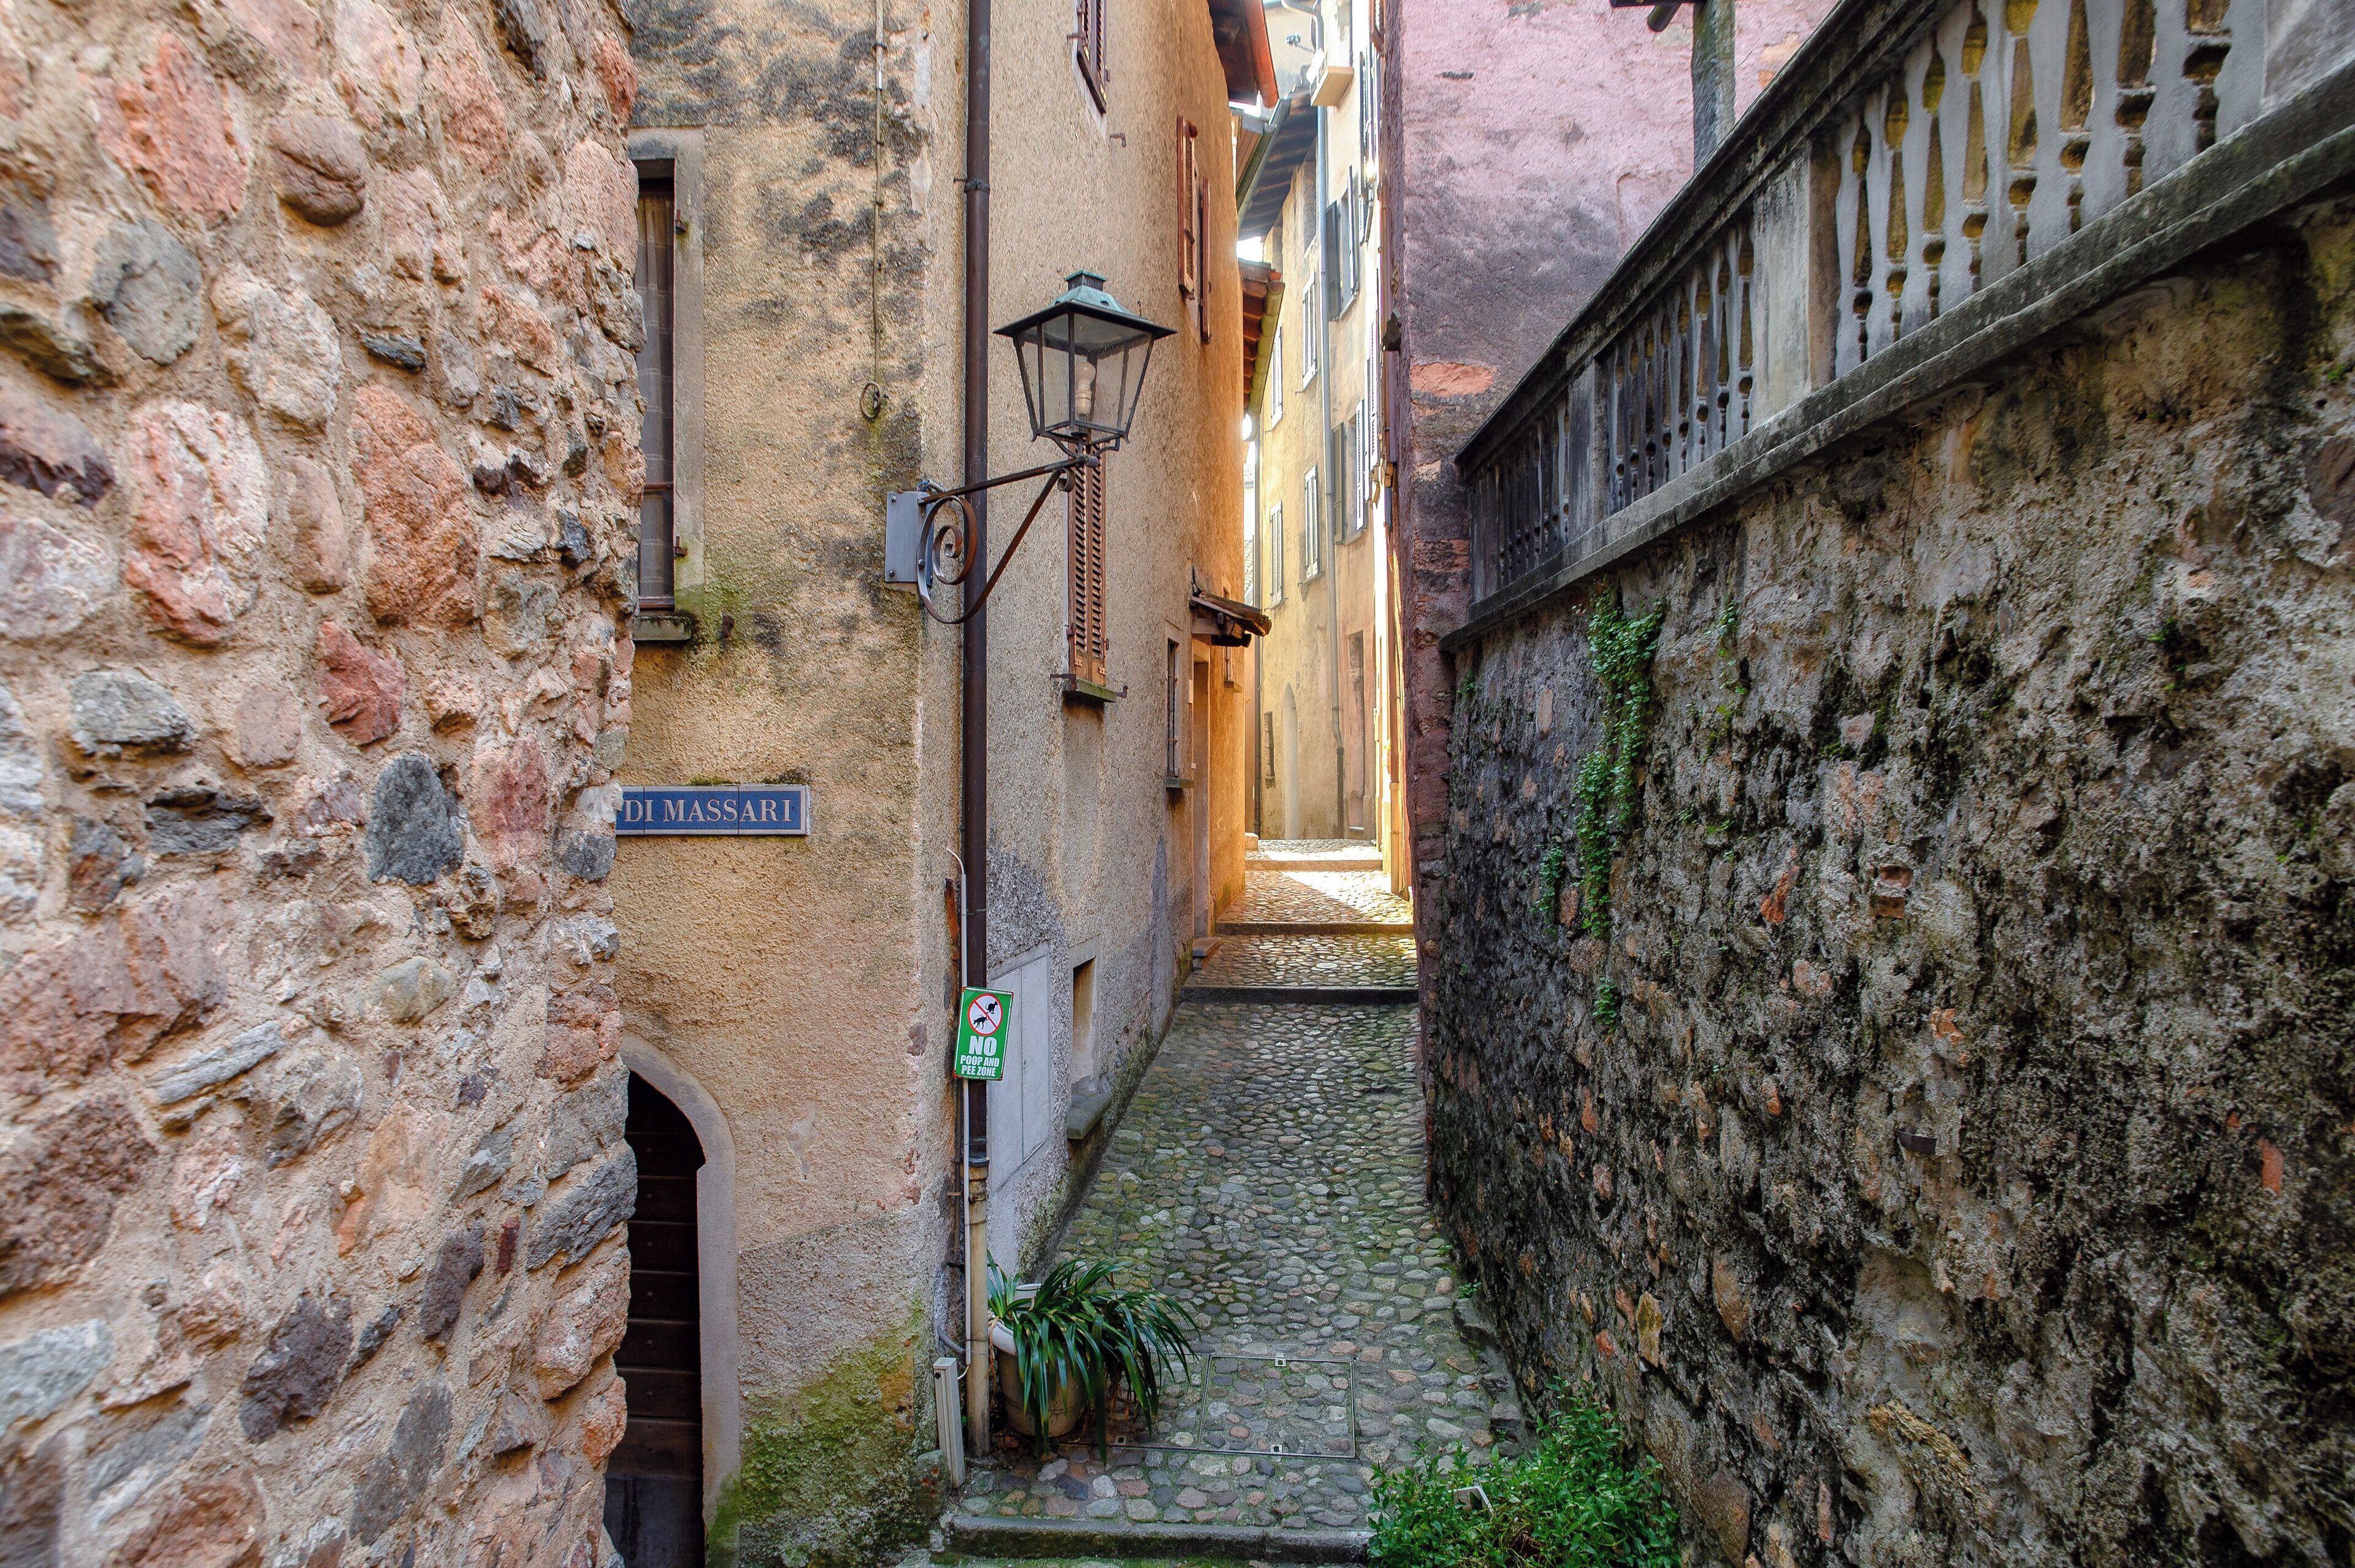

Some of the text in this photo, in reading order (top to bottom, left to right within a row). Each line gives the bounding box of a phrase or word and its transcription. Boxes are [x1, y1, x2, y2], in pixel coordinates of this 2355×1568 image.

[624, 799, 792, 822] DI MASSARI
[969, 1036, 997, 1056] NO
[960, 1055, 1000, 1067] POOP AND
[961, 1065, 996, 1077] PEE ZONE
